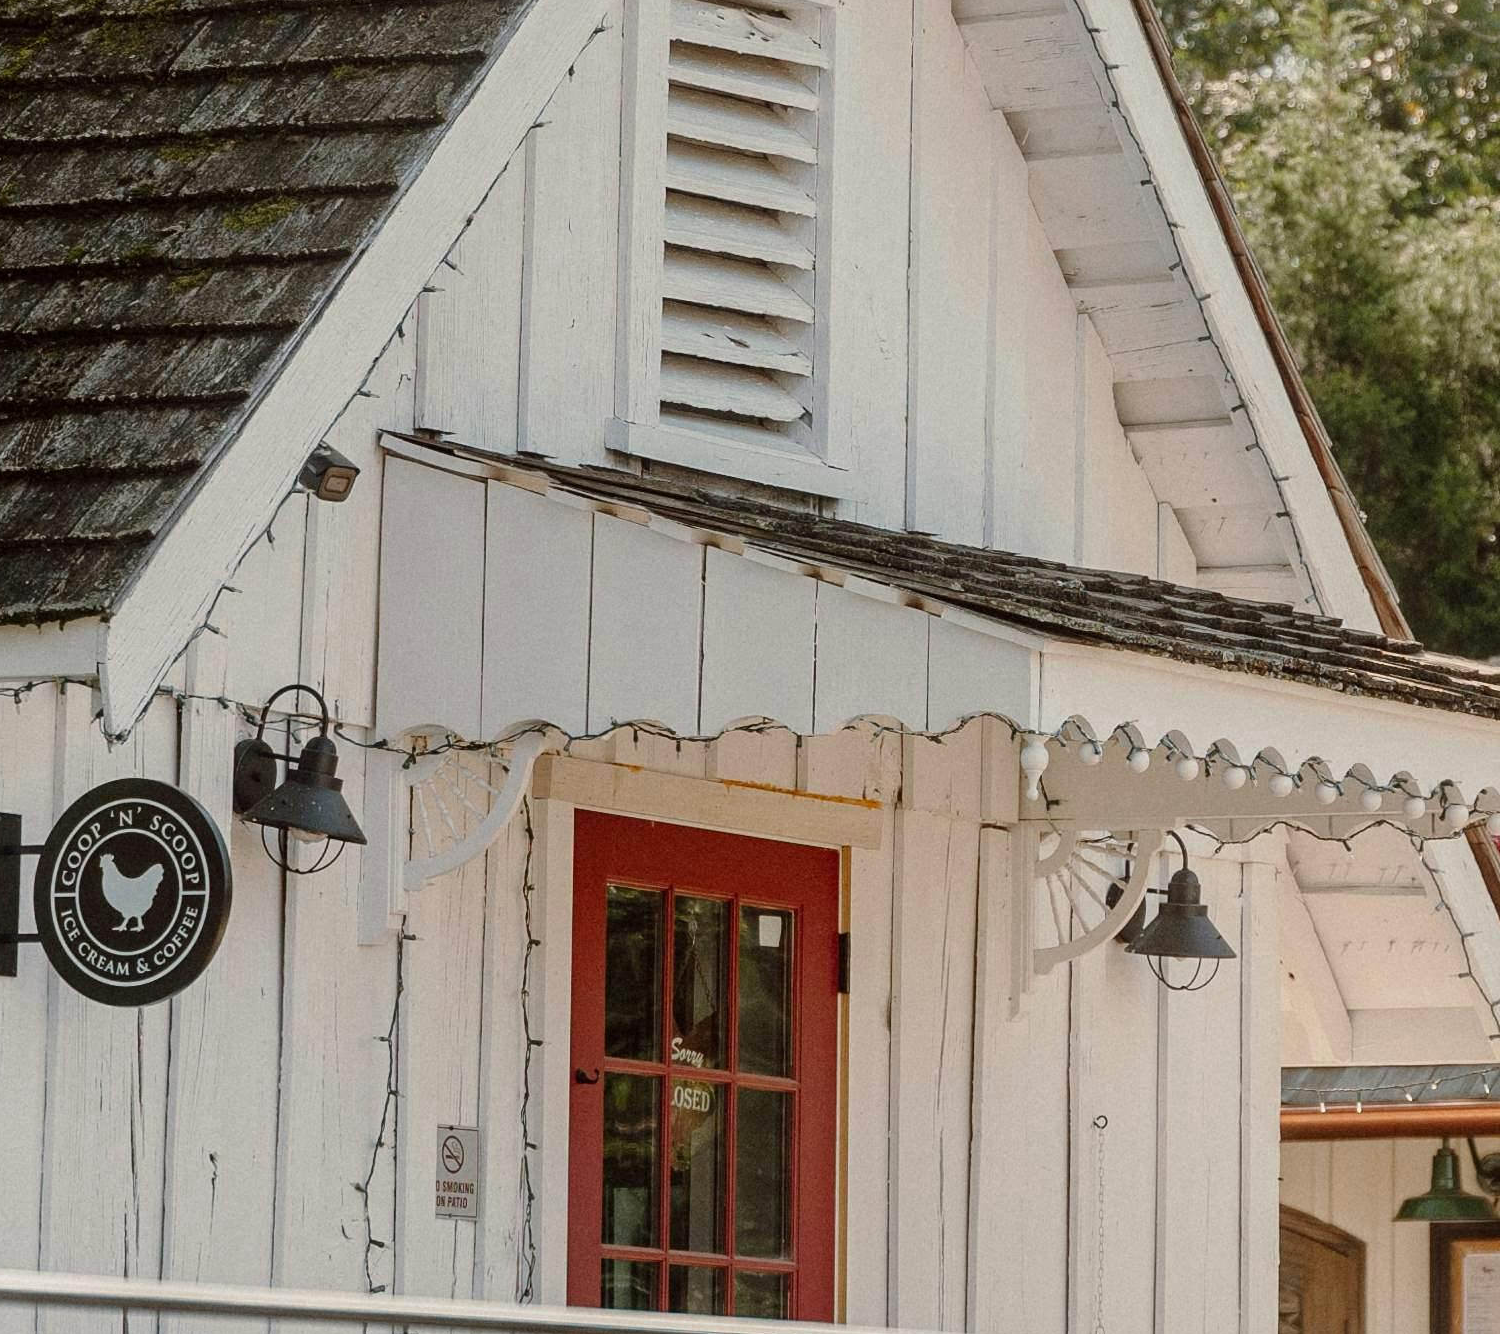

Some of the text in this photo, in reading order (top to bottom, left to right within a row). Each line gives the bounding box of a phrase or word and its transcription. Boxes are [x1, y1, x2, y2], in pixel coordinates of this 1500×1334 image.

[61, 822, 102, 886] COOP
[150, 815, 200, 884] SCOOP
[60, 906, 199, 976] ICE CREAM & COFFEE
[671, 1037, 705, 1069] Sorry
[671, 1085, 711, 1113] OSED
[436, 1195, 468, 1208] ON PATIO
[442, 1181, 474, 1194] SMOKING
